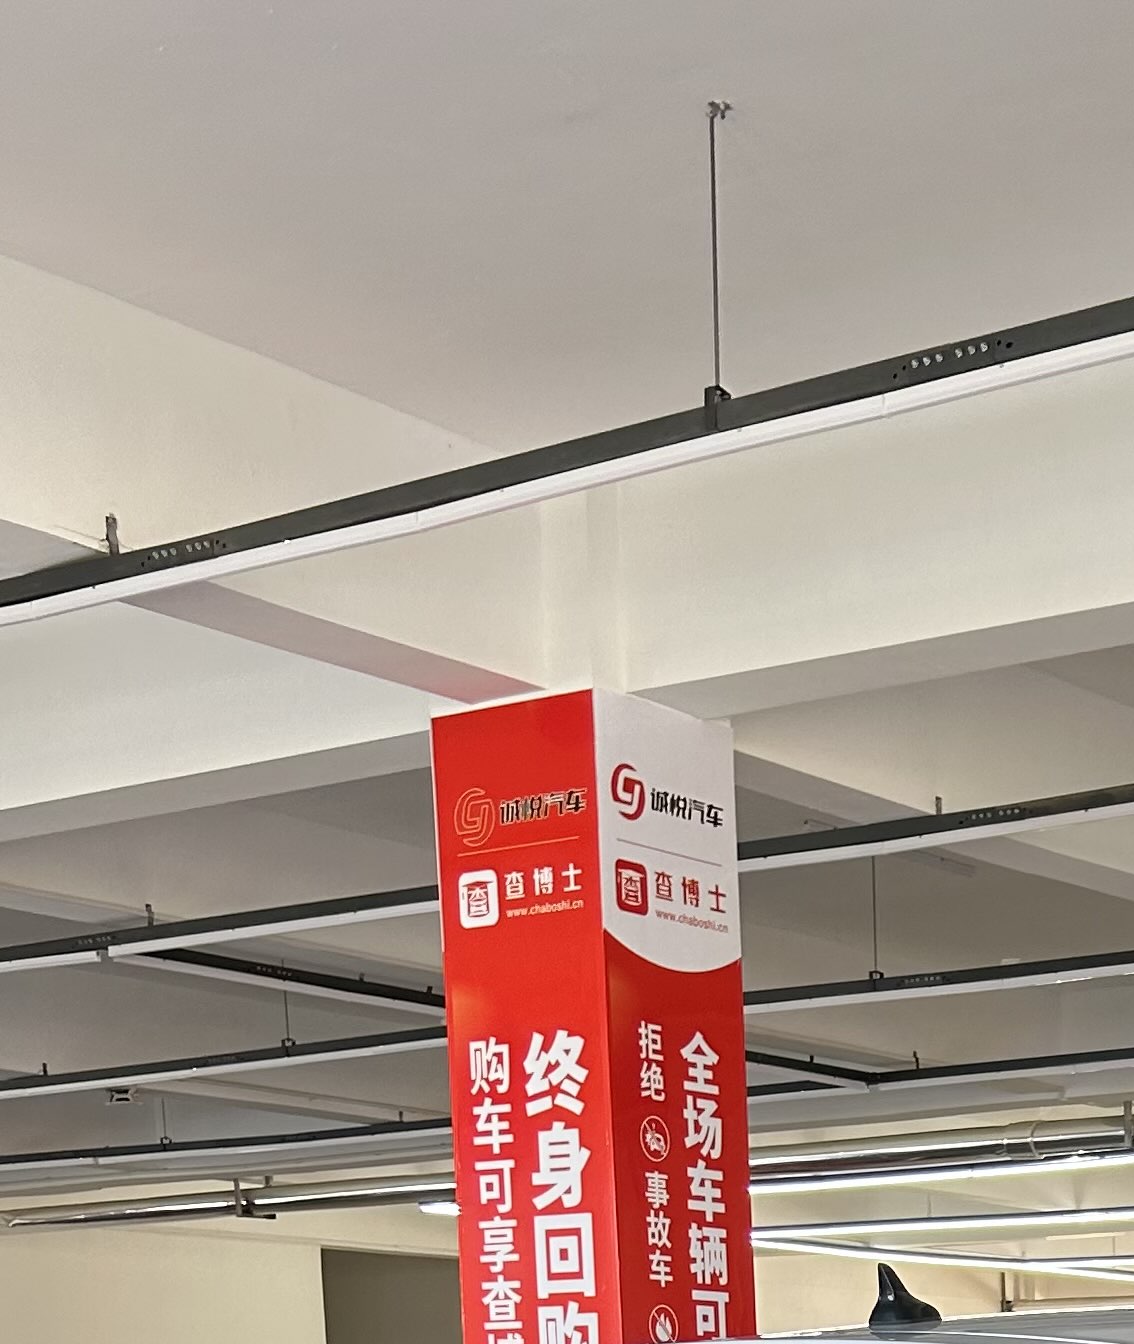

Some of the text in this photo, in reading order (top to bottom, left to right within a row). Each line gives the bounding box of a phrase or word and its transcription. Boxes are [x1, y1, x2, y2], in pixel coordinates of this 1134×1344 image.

[651, 787, 724, 828] 诚悦汽车
[504, 862, 583, 901] 查博士
[654, 871, 727, 914] 查博士
[638, 1020, 674, 1288] 拒绝 事故车
[680, 1031, 730, 1341] 全场车辆可
